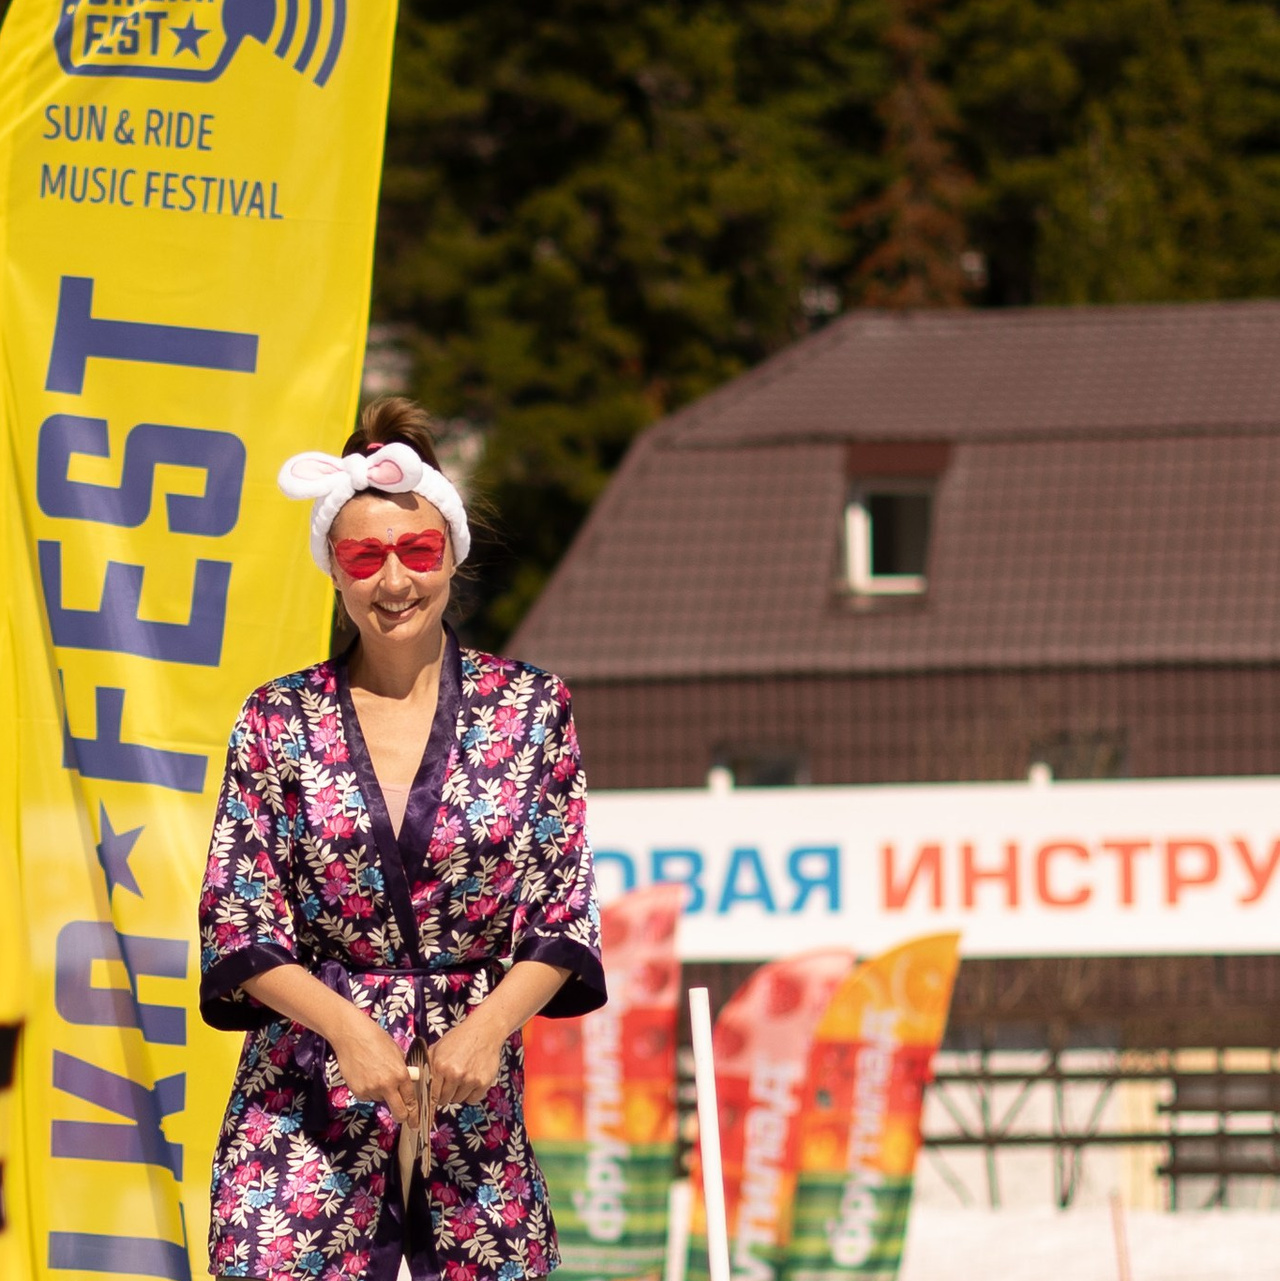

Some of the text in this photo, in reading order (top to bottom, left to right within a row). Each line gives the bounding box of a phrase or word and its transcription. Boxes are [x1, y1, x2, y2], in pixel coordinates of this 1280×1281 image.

[83, 11, 169, 57] FEST
[42, 104, 215, 151] SUN & RIDE
[39, 163, 284, 221] MUSIC FESTIVAL
[36, 274, 260, 794] FEST
[880, 836, 1280, 911] ИНСТРУ
